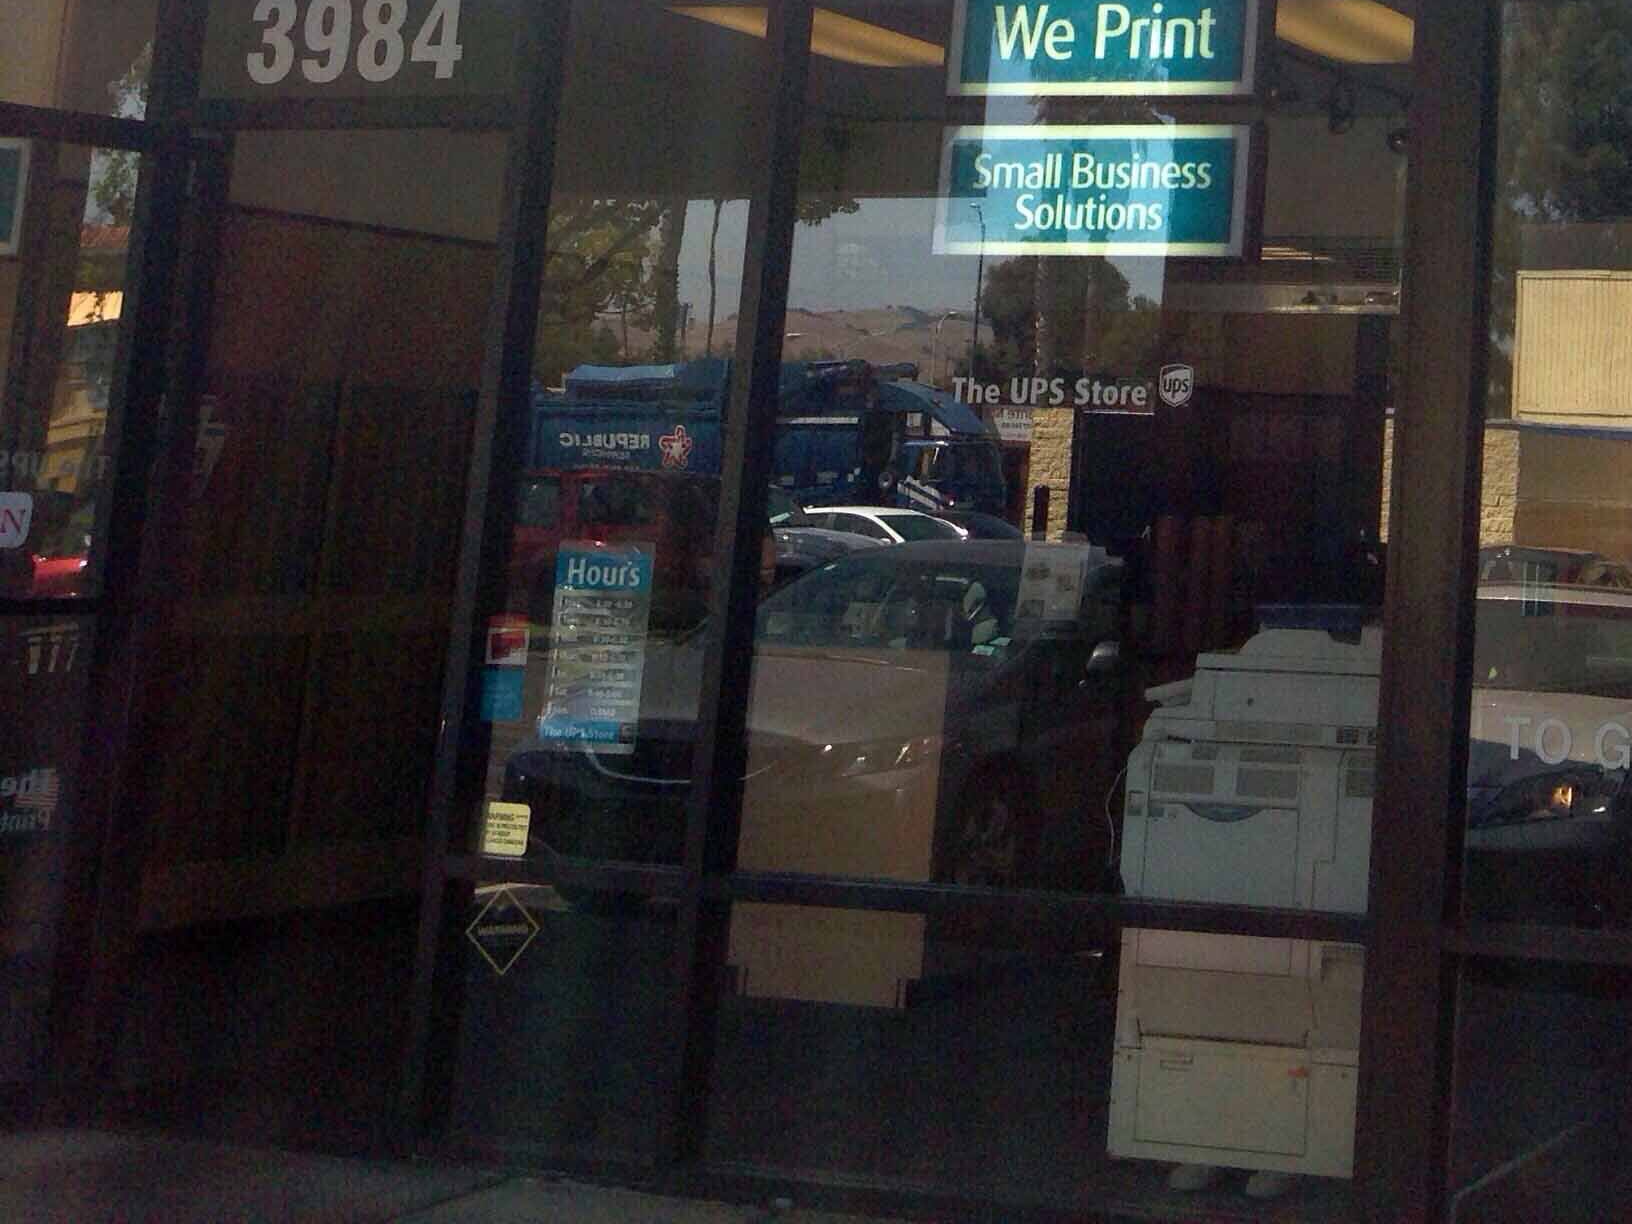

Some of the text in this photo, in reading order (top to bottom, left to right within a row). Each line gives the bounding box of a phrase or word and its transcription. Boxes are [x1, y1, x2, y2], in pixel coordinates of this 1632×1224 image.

[995, 2, 1217, 60] We Print
[972, 152, 1213, 190] Small Business
[1014, 194, 1164, 231] Solutions
[951, 377, 1148, 406] The UPS Store
[1163, 378, 1190, 400] ups
[1503, 716, 1573, 765] TO
